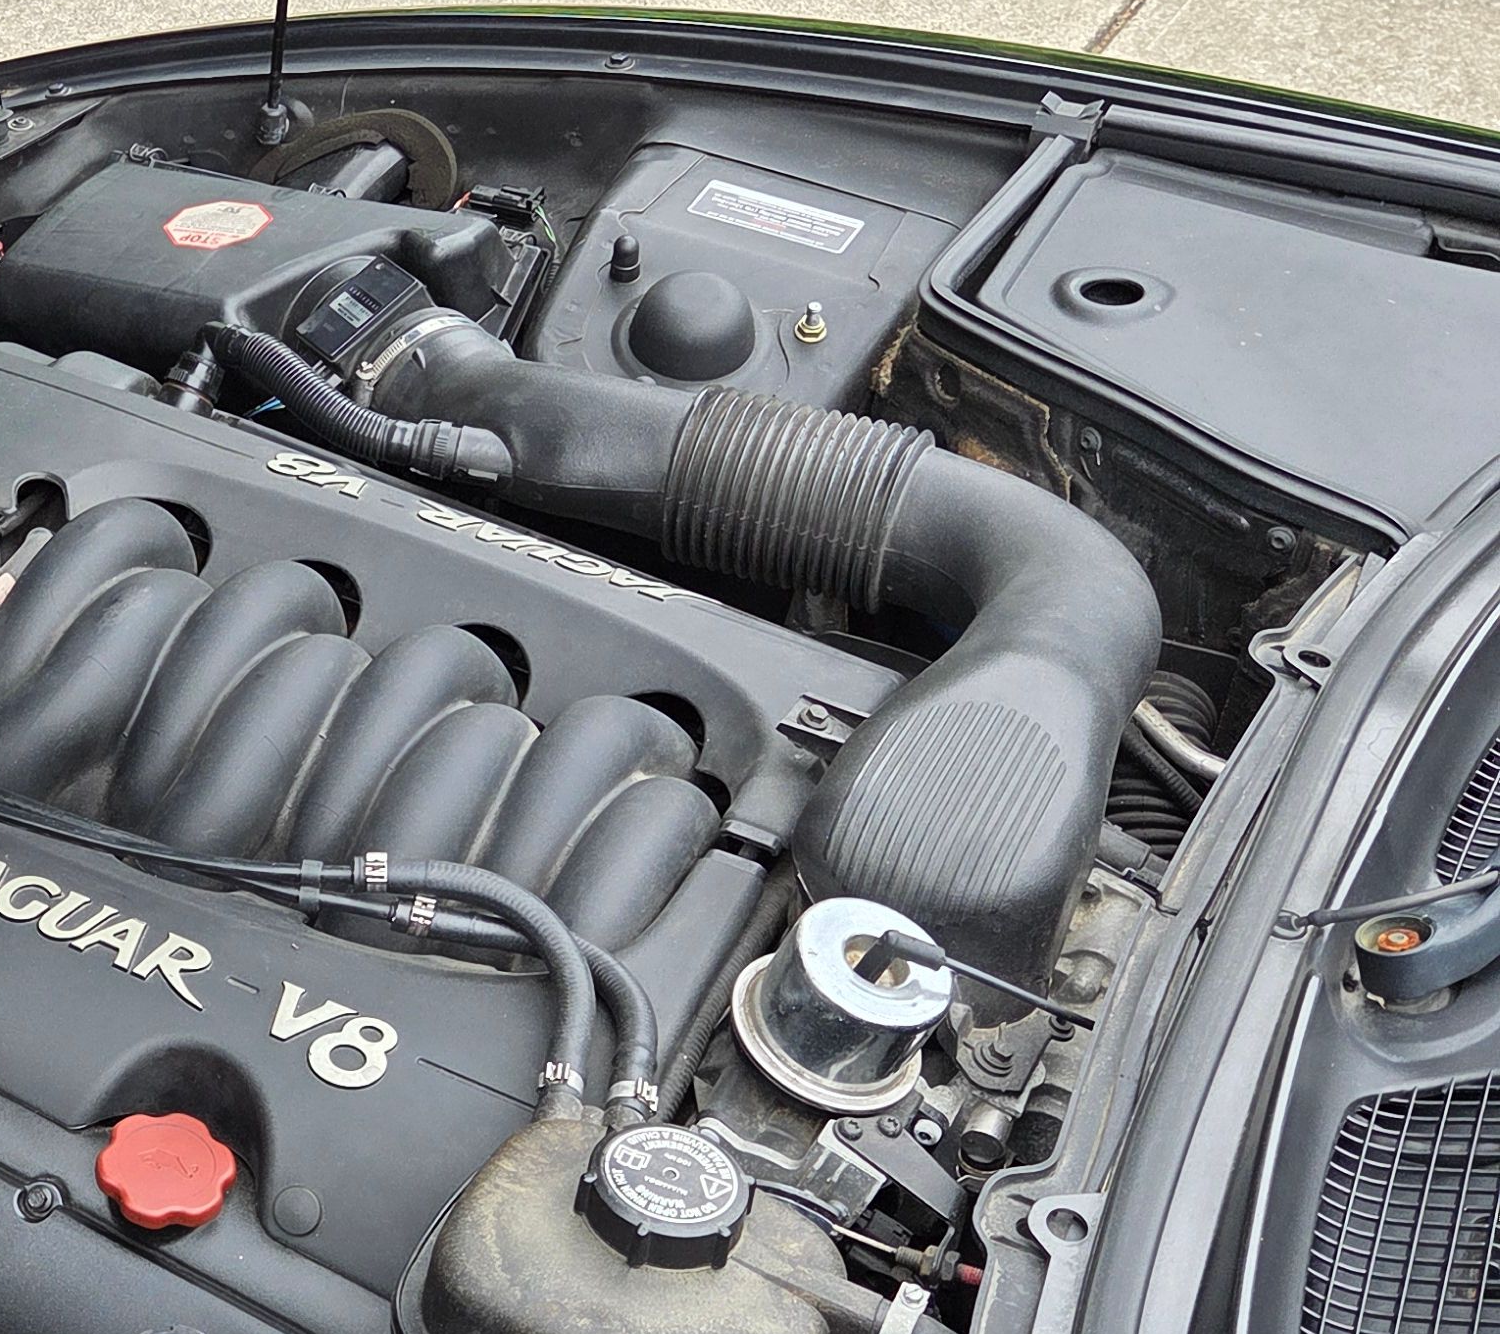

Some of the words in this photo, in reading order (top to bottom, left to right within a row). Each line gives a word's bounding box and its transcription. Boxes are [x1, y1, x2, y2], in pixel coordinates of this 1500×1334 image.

[179, 234, 220, 245] STOP
[267, 451, 367, 499] V8
[417, 499, 721, 604] JAGUAR
[268, 980, 399, 1089] V8
[626, 1131, 661, 1145] CHAUD
[672, 1132, 708, 1153] OUVRIR
[641, 1140, 718, 1174] AVERTISSEMENT
[708, 1150, 727, 1170] PAS
[611, 1168, 627, 1185] HOT
[620, 1184, 649, 1208] WHEN
[635, 1184, 686, 1208] WARNING
[648, 1203, 678, 1217] OPEN
[680, 1207, 703, 1218] NOT
[700, 1202, 718, 1214] DO
